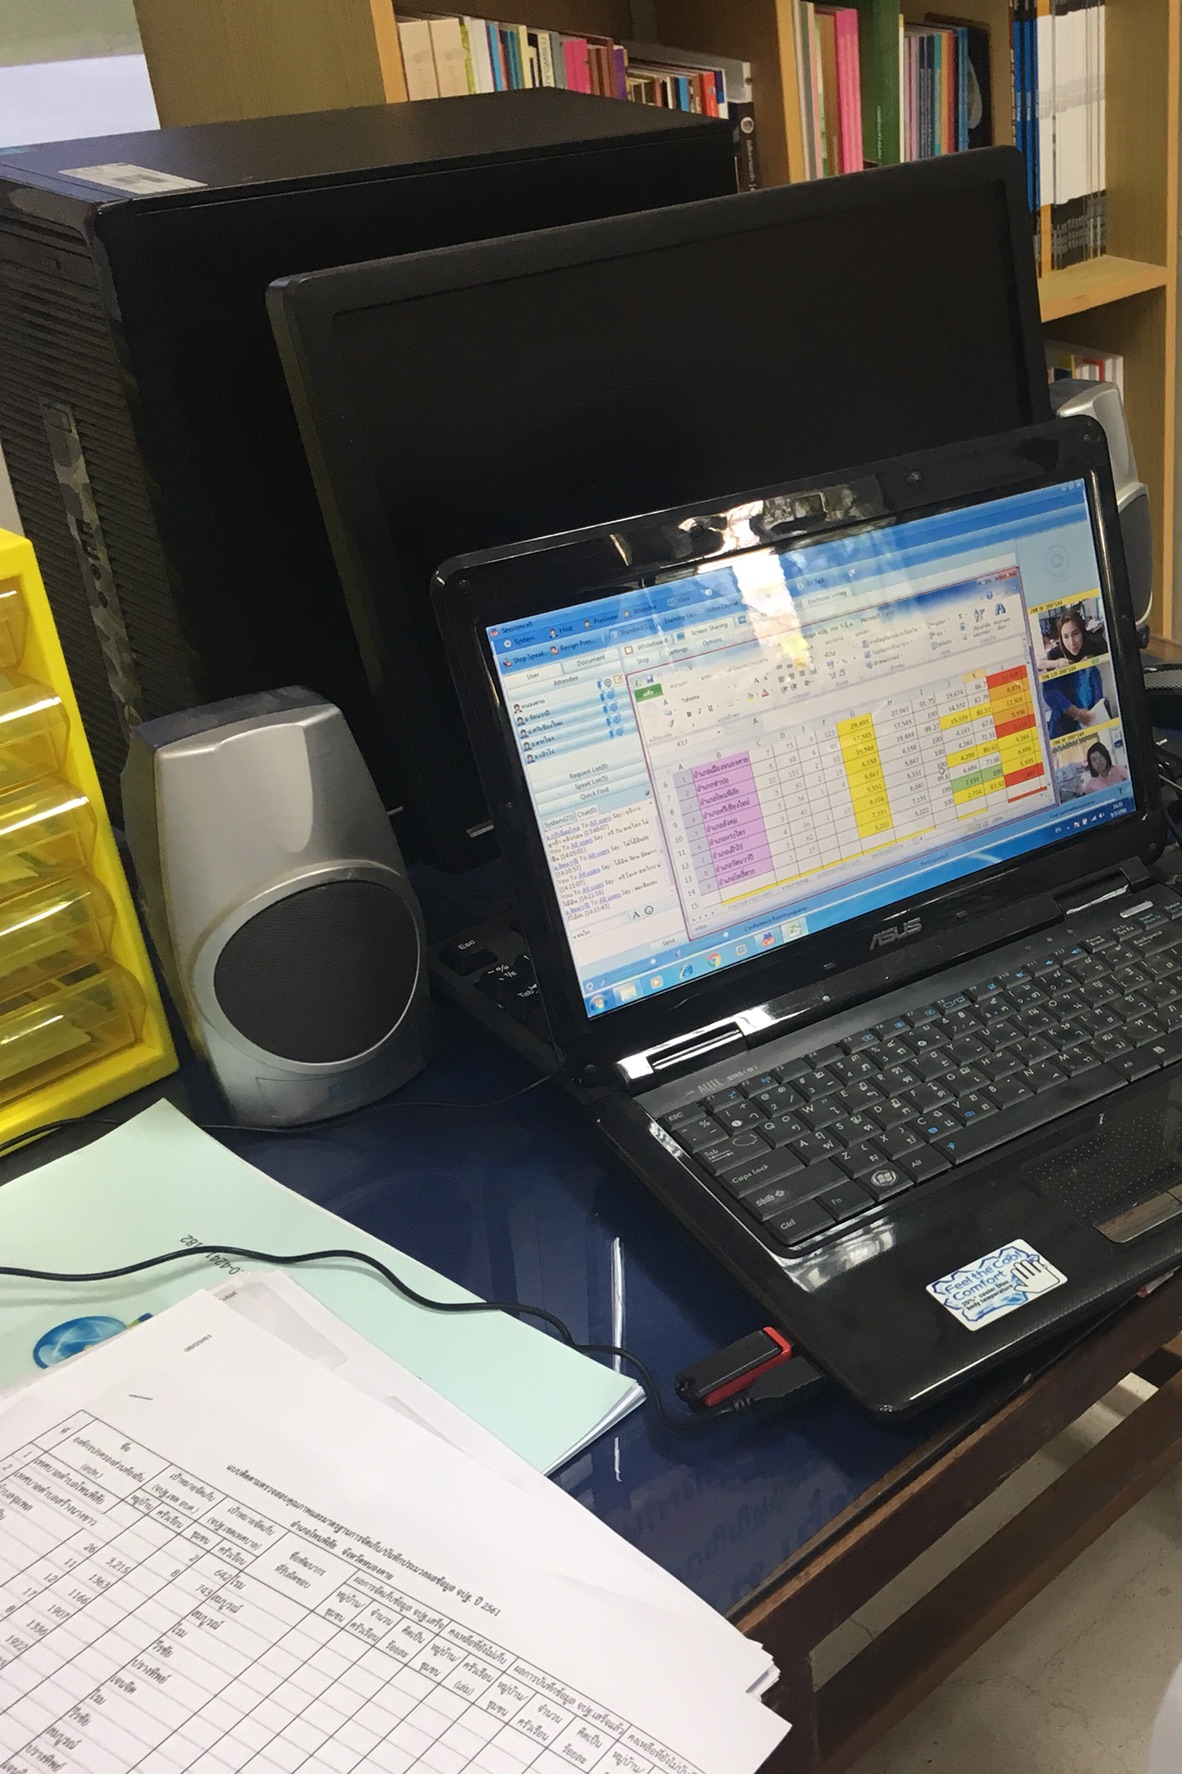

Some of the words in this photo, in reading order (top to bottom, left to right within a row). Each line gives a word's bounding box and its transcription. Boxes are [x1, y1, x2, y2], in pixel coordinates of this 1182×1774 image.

[702, 637, 723, 647] Options
[576, 654, 606, 667] Document
[580, 791, 597, 801] Quick
[596, 786, 610, 795] Find
[944, 1275, 973, 1294] Feel
[972, 1265, 993, 1280] the
[993, 1251, 1022, 1269] Cool
[952, 1270, 1008, 1301] Comfort
[480, 1602, 501, 1617] 2561
